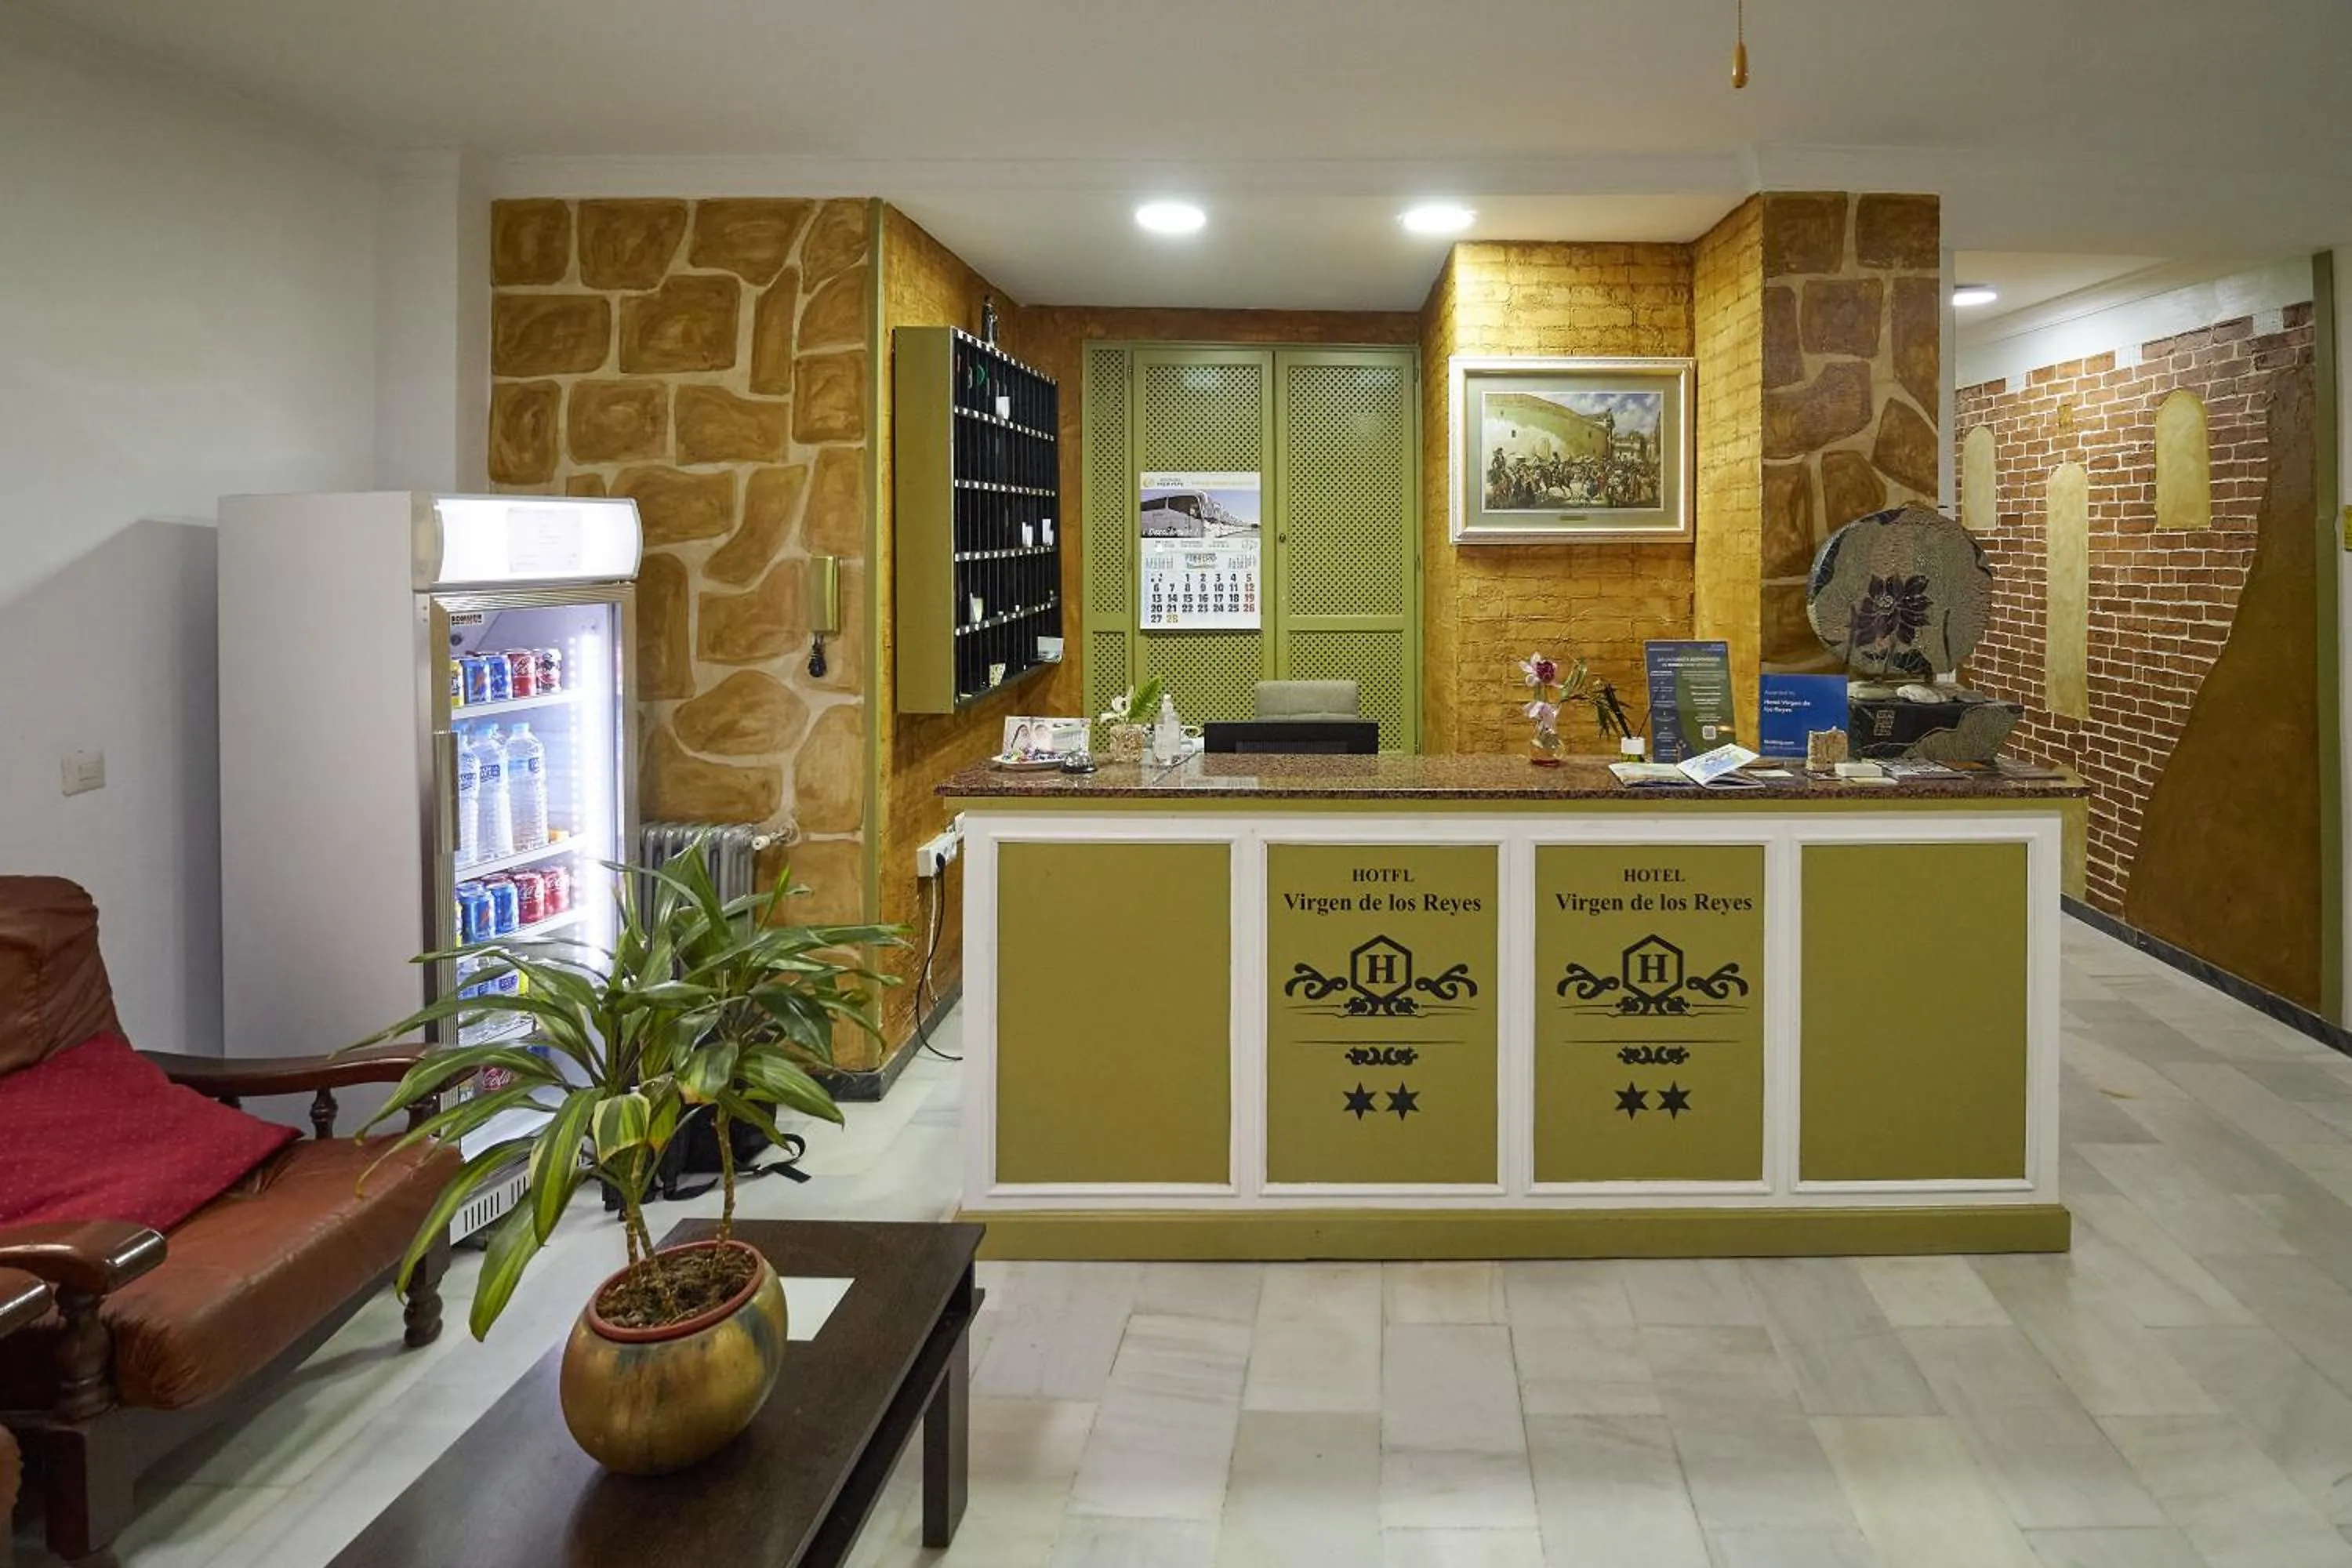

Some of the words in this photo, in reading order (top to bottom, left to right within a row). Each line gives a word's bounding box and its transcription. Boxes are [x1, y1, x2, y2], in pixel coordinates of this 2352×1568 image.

[1185, 573, 1190, 582] 1
[1200, 573, 1207, 582] 2
[1215, 573, 1221, 582] 3
[1230, 573, 1236, 582] 4
[1153, 583, 1160, 592] 6
[1169, 583, 1175, 592] 7
[1185, 583, 1191, 592] 8
[1200, 583, 1207, 592] 9
[1214, 583, 1224, 592] 10
[1229, 583, 1238, 592] 11
[1244, 583, 1254, 592] 12
[1152, 593, 1162, 603] 13
[1167, 593, 1178, 603] 14
[1183, 593, 1192, 603] 15
[1199, 593, 1208, 603] 16
[1214, 593, 1224, 603] 17
[1229, 593, 1239, 603] 18
[1245, 593, 1255, 603] 19
[1150, 604, 1162, 612] 20
[1167, 604, 1177, 612] 21
[1181, 604, 1193, 612] 22
[1213, 604, 1224, 612] 24
[1228, 604, 1239, 612] 25
[1150, 615, 1162, 623] 27
[1352, 869, 1415, 882] HOTEL
[1624, 869, 1685, 882] HOTEL
[1284, 894, 1352, 916] Virgen
[1359, 894, 1382, 911] de
[1389, 894, 1416, 911] los
[1424, 894, 1481, 916] Reyes
[1555, 894, 1623, 916] Virgen
[1631, 894, 1653, 911] de
[1661, 894, 1686, 911] los
[1694, 894, 1752, 916] Reyes
[1367, 954, 1396, 984] H
[1638, 953, 1668, 983] H
